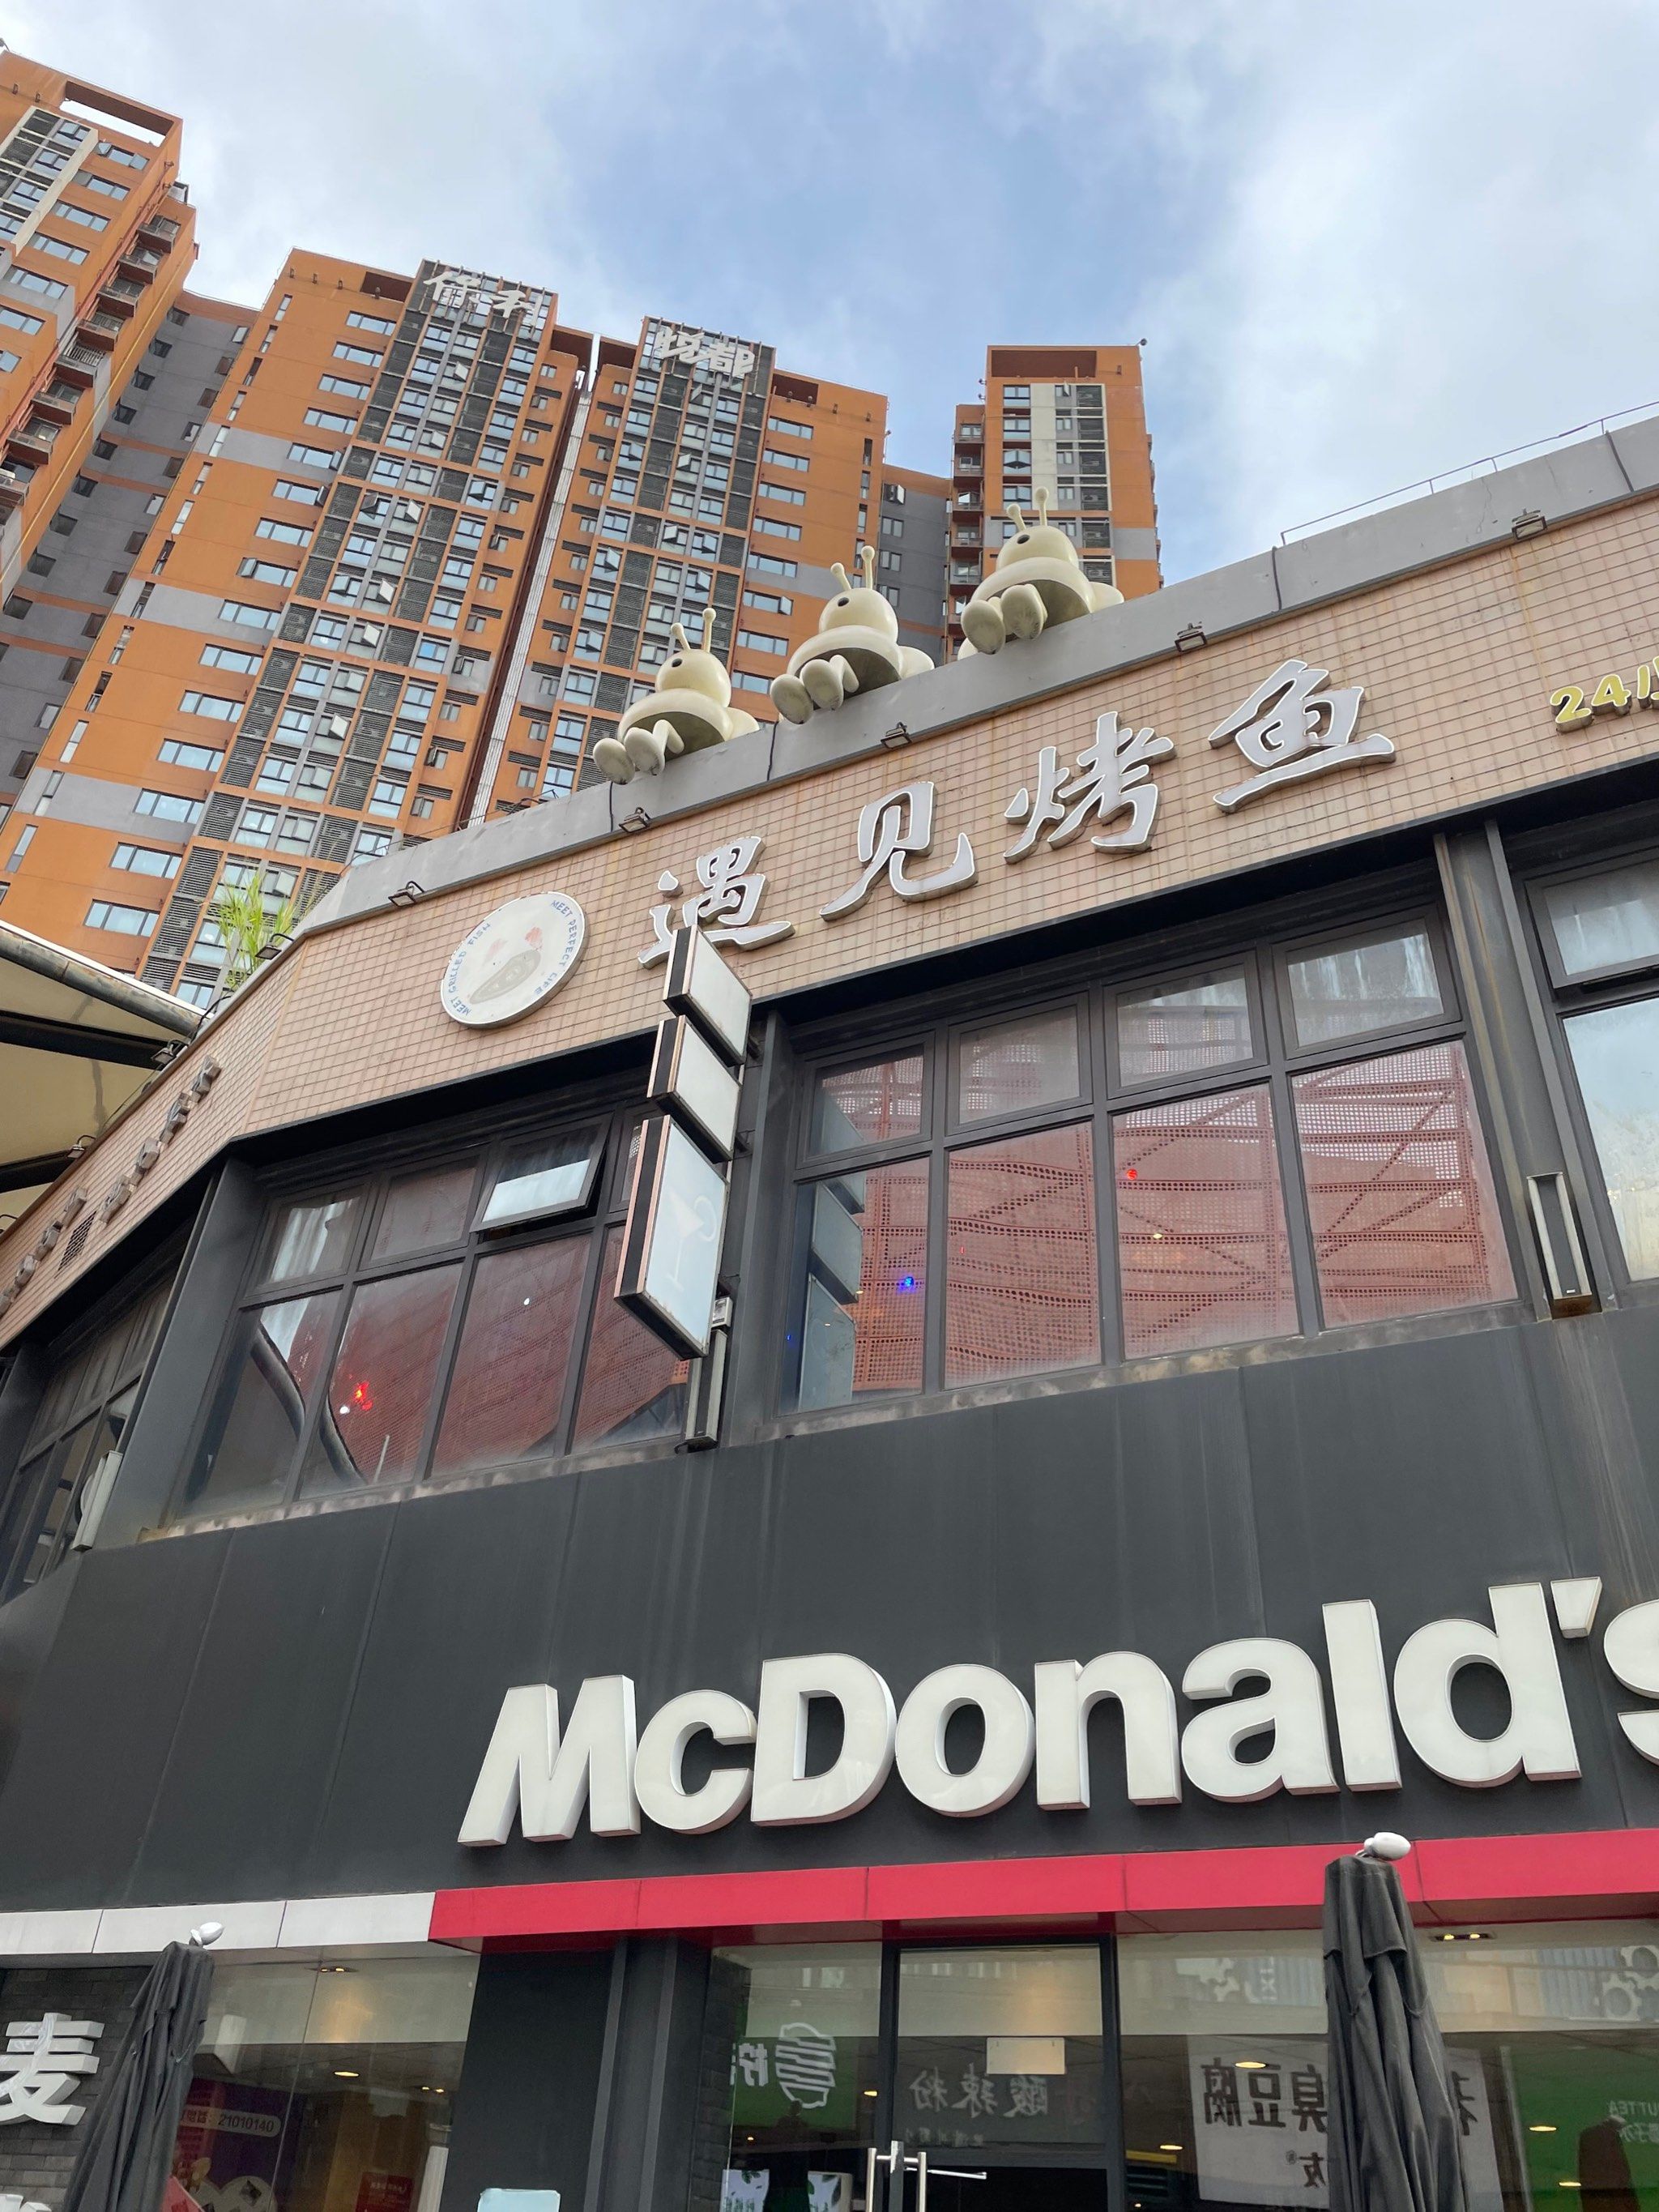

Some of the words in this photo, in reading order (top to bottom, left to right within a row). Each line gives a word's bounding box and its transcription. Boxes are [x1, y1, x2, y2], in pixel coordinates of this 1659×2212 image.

[637, 659, 1396, 969] 遇见烤鱼
[550, 899, 574, 918] MEET
[559, 919, 578, 967] PERFECT
[448, 950, 467, 993] GRILLED
[534, 972, 557, 995] LIFE
[450, 997, 472, 1016] MEET
[218, 2112, 275, 2133] 21010140
